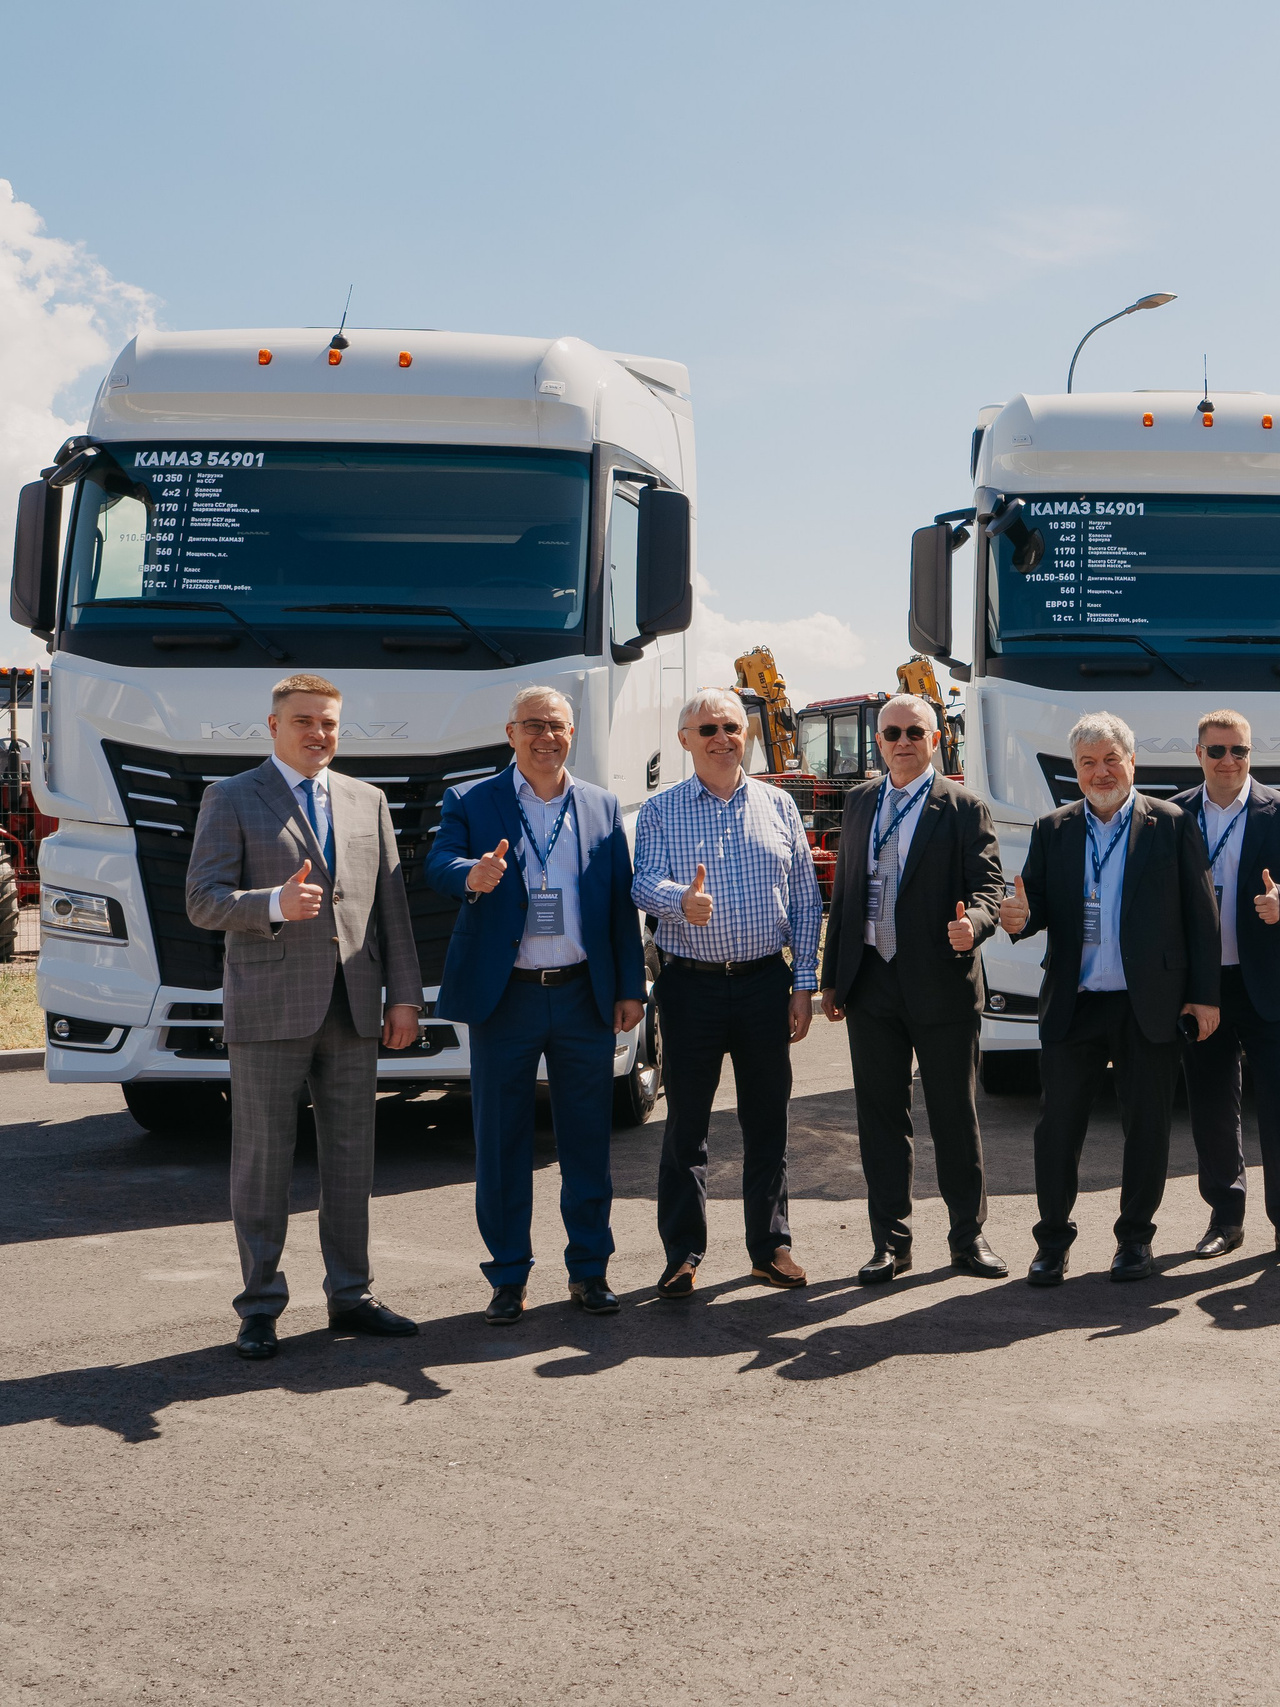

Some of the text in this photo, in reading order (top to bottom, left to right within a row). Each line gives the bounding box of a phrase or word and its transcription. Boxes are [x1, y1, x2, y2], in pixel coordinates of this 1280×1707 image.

[134, 452, 264, 467] КАМАЗ 54901
[152, 474, 182, 482] 10 350
[154, 503, 178, 512] 1170
[1030, 502, 1144, 516] КАМАЗ 54901
[152, 518, 176, 526] 1140
[120, 533, 174, 542] 910.50-560
[156, 548, 172, 556] 560
[138, 564, 170, 572] ЕВРО 5
[1054, 560, 1075, 568] 1140
[1026, 573, 1075, 582] 910.50-560
[200, 722, 408, 740] KAAZ
